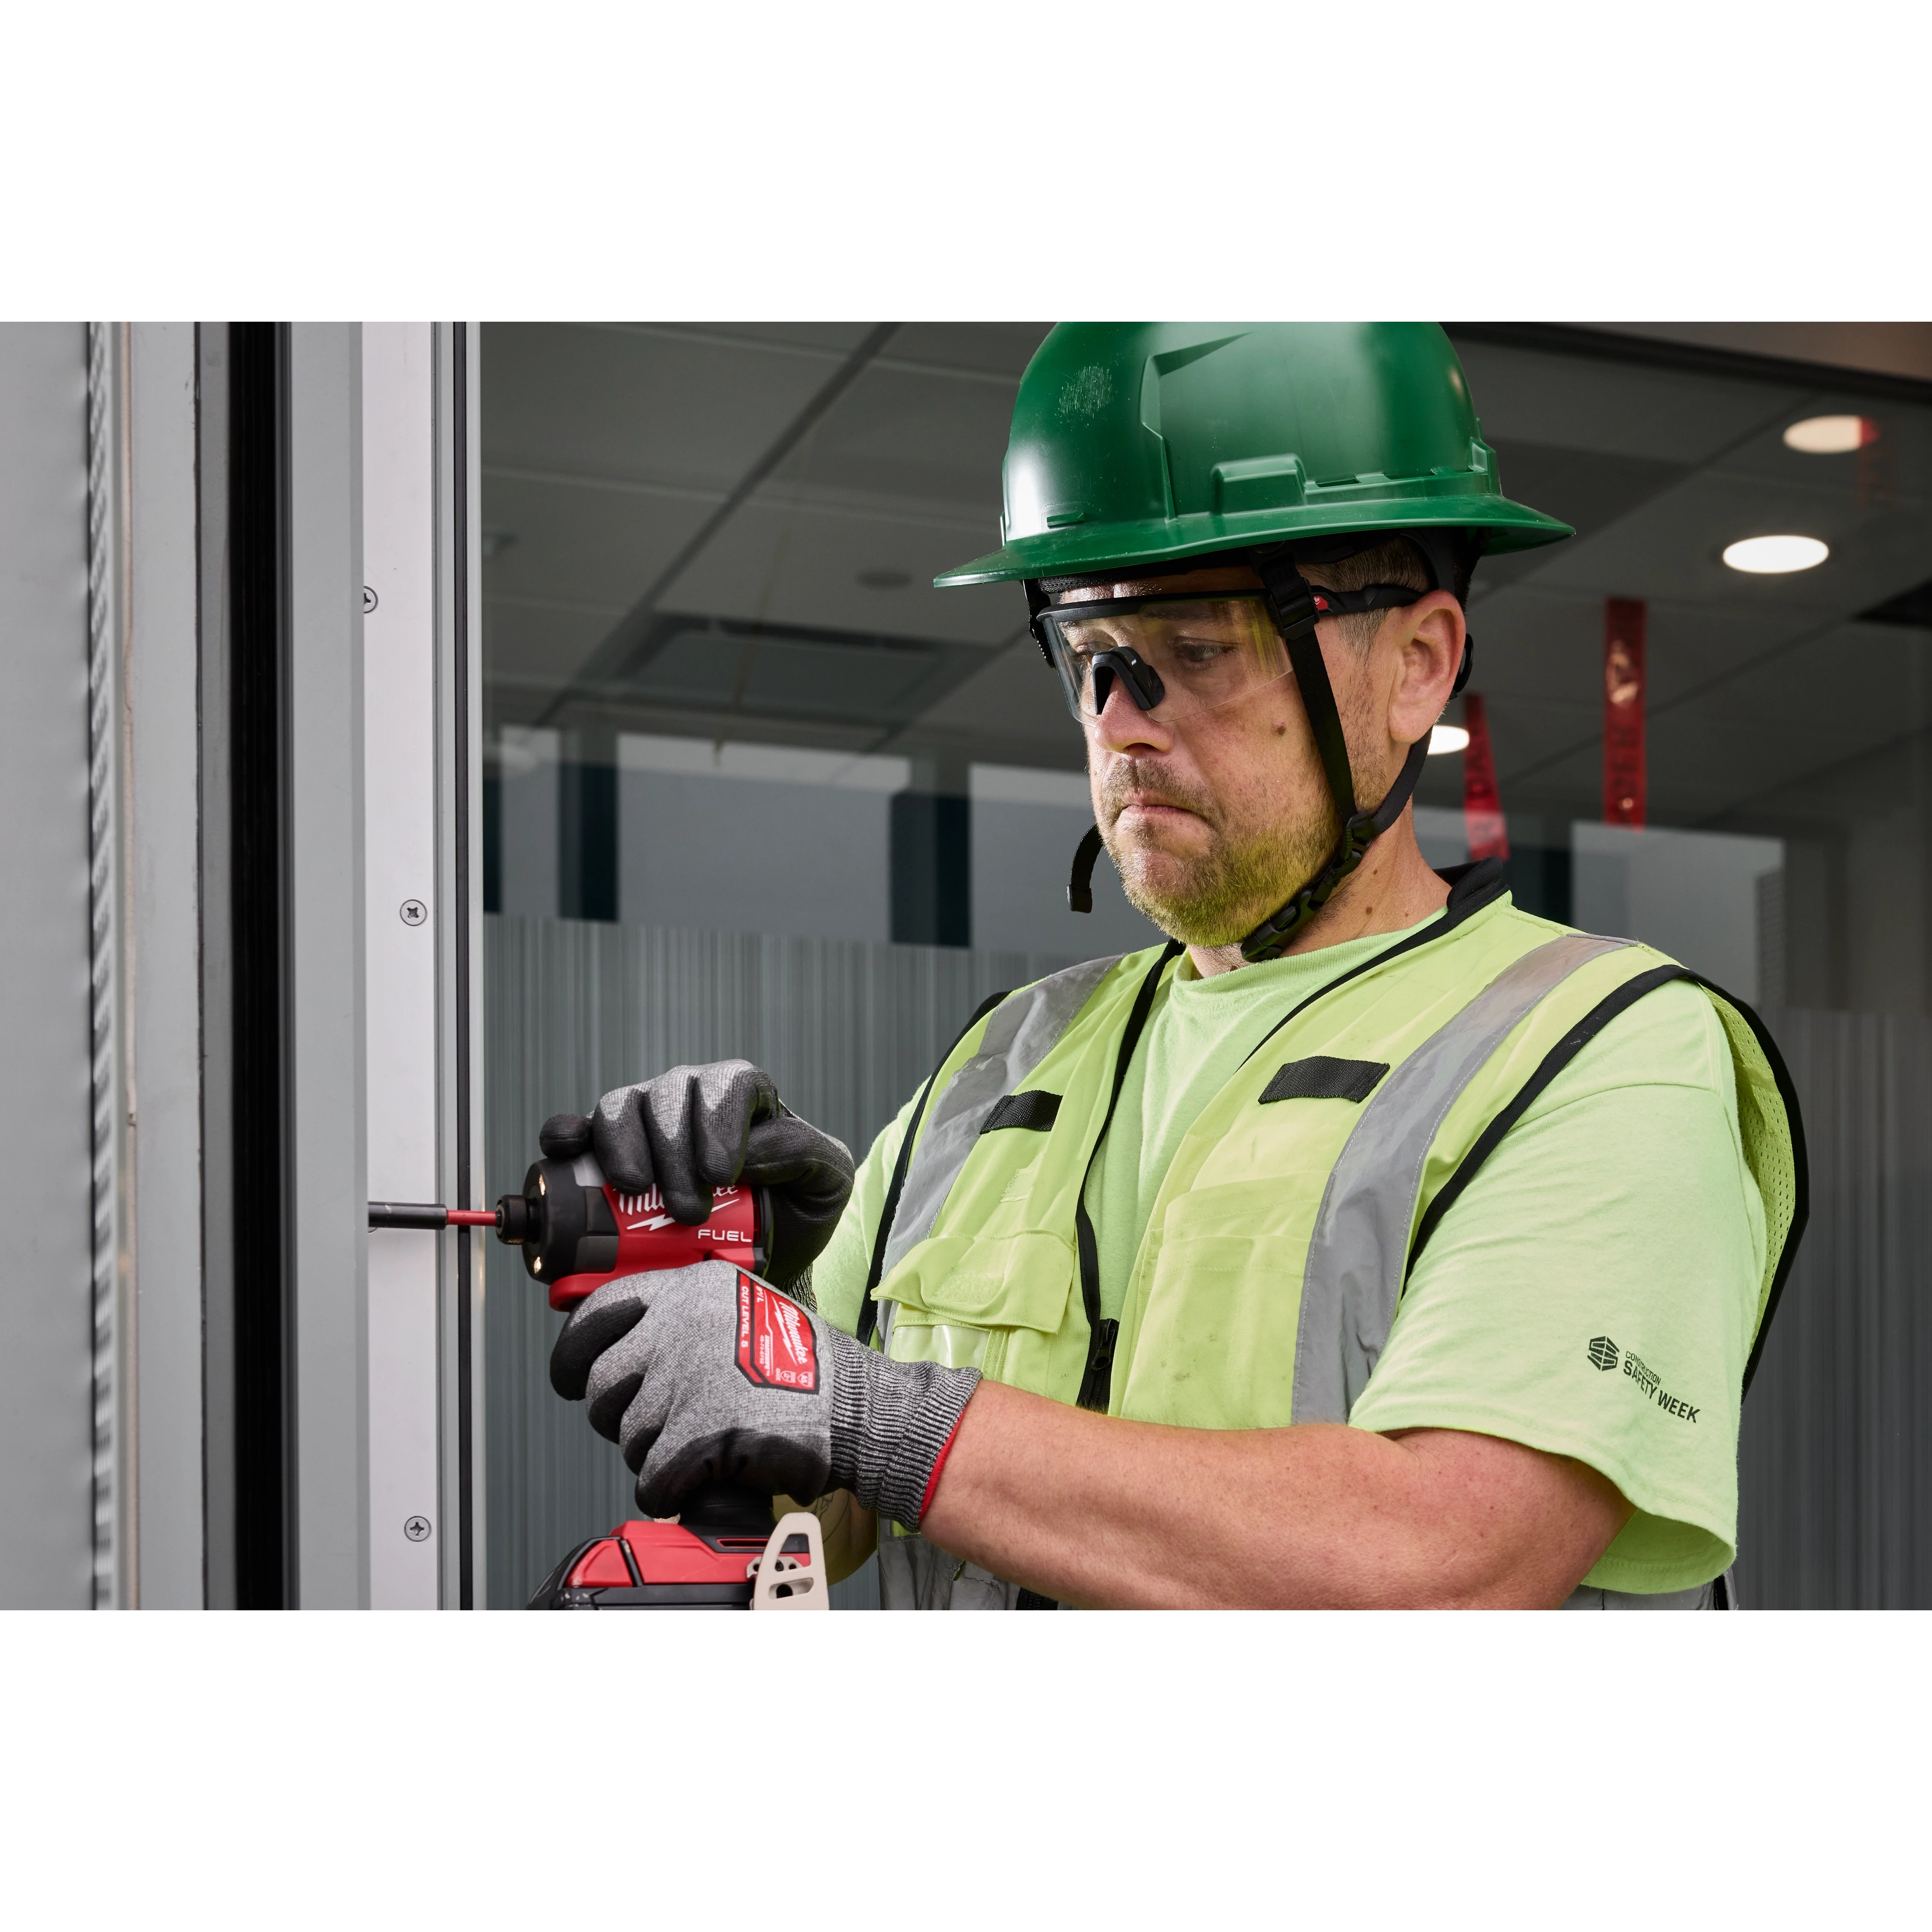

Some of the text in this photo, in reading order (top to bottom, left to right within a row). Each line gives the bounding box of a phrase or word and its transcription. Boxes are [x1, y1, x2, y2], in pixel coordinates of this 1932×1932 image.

[698, 1229, 752, 1242] FUEL
[779, 1302, 808, 1364] Milwaukee
[802, 1375, 808, 1383] A5
[1626, 1351, 1661, 1385] CONSTRUCTION
[1623, 1360, 1701, 1423] SAFETY WEEK
